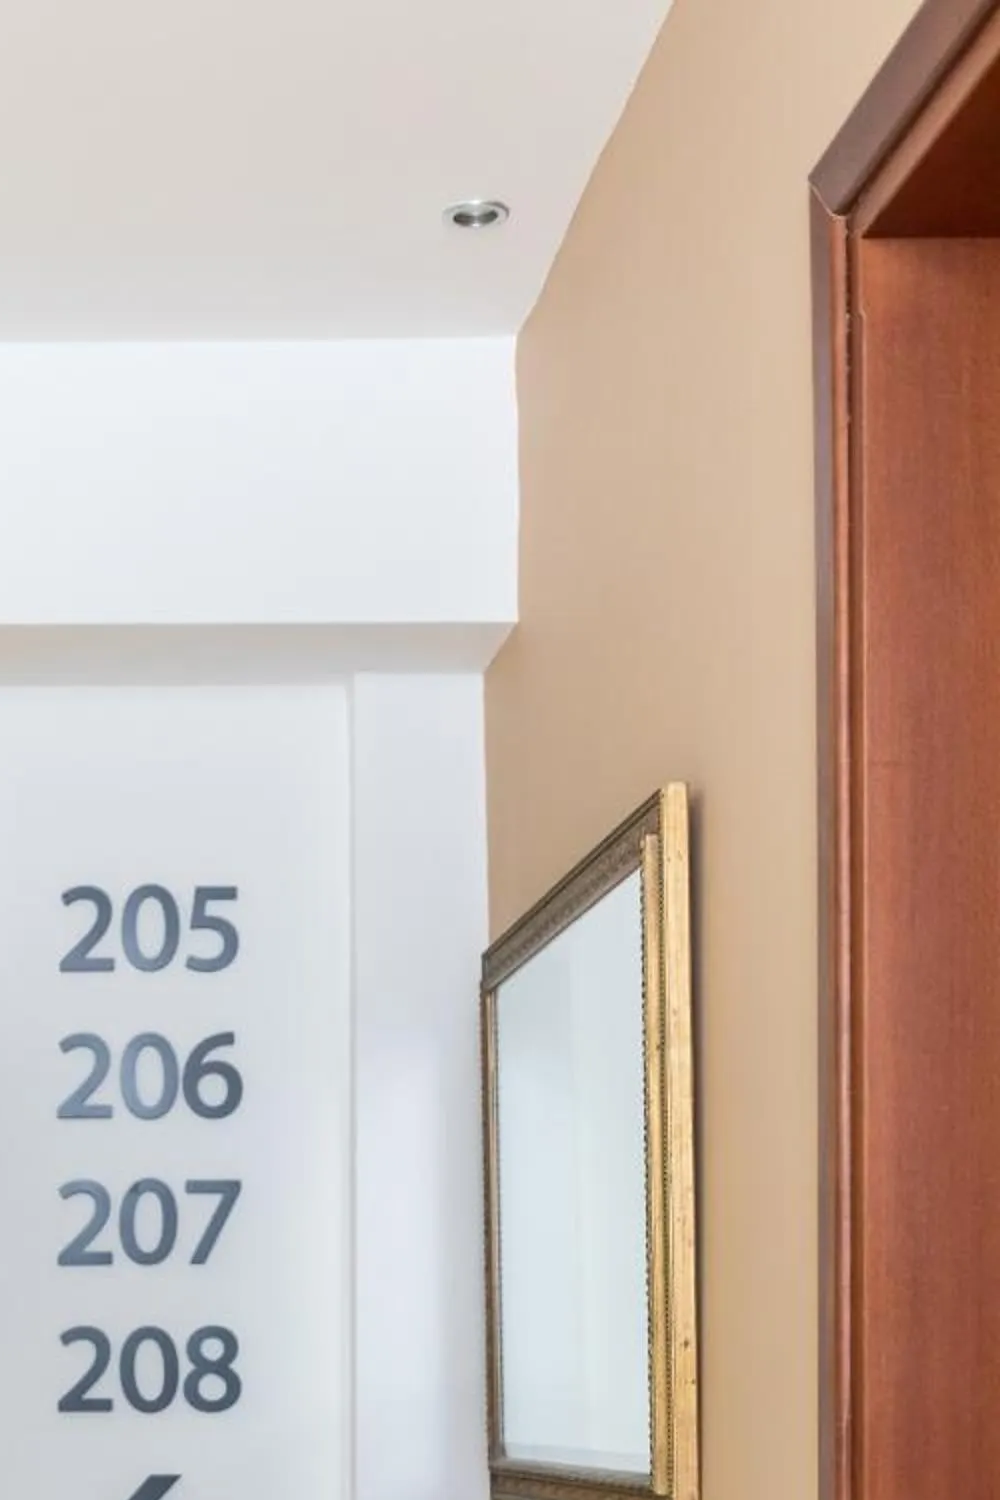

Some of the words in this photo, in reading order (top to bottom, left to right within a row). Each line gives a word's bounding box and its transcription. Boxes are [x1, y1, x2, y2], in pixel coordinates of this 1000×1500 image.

[59, 885, 239, 973] 205
[57, 1032, 244, 1121] 206
[56, 1178, 242, 1267] 207
[57, 1325, 243, 1415] 208
